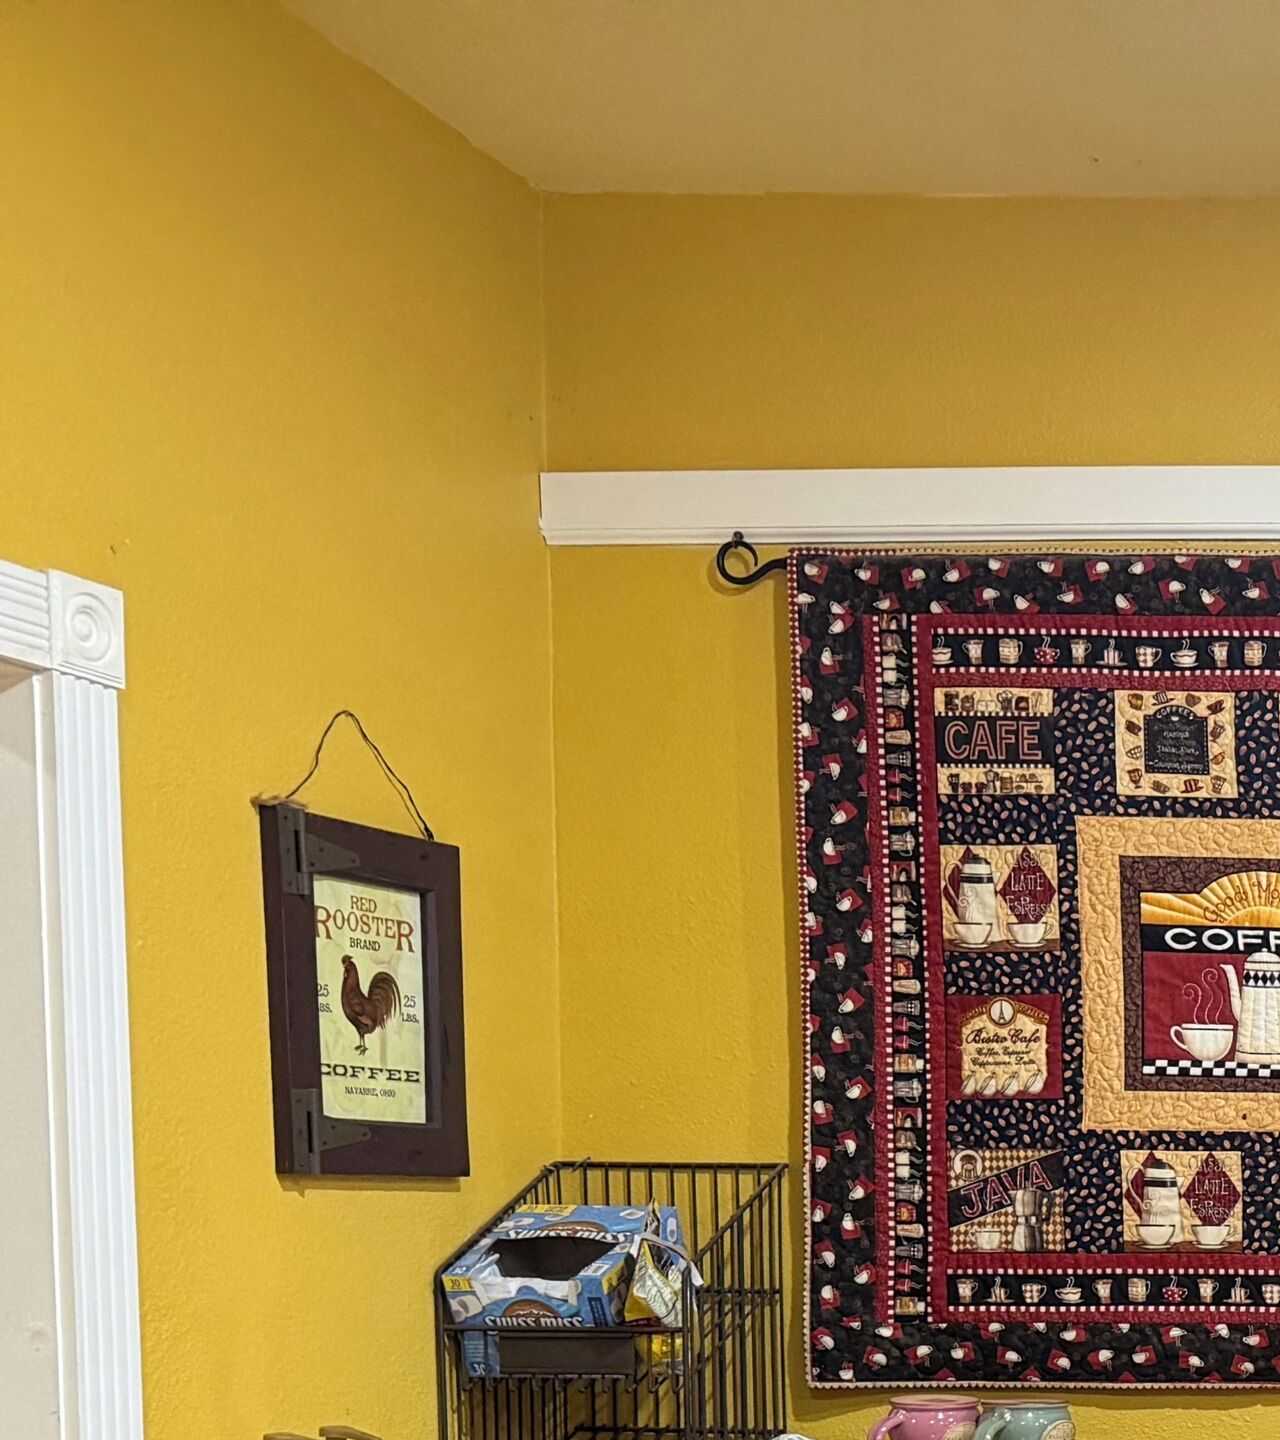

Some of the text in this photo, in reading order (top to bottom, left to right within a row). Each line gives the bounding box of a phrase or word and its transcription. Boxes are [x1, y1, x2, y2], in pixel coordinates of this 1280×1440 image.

[945, 721, 1042, 760] CAFE
[1011, 872, 1045, 891] LATTE
[350, 895, 377, 913] RED
[1204, 886, 1248, 924] Good
[315, 905, 415, 953] ROOSTER
[350, 937, 380, 952] BRAND
[403, 995, 416, 1009] 25
[966, 1027, 1006, 1044] Bistro
[320, 1063, 420, 1083] COFFEE
[960, 1161, 1053, 1217] JAVA
